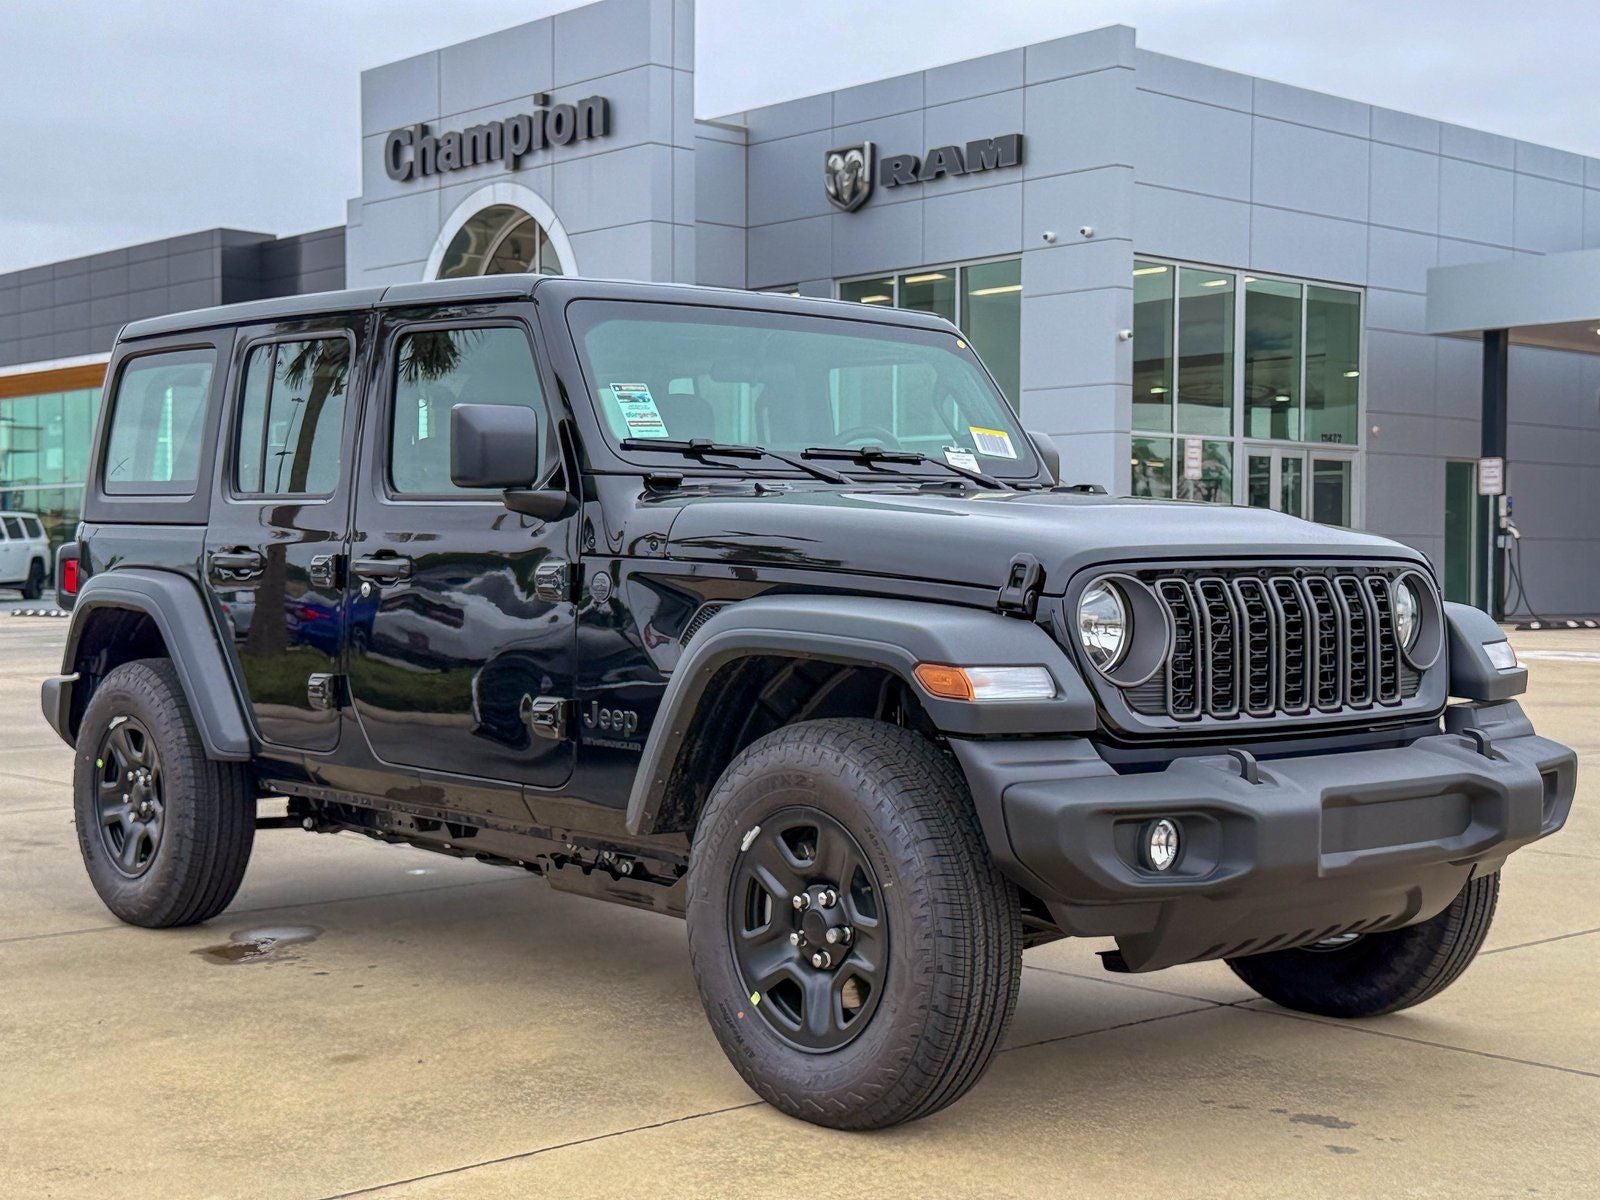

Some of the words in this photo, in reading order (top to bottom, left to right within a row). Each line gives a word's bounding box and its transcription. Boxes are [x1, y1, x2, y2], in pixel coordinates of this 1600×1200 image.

[384, 93, 610, 182] Champion
[880, 134, 1023, 188] RAM
[583, 700, 638, 738] Jeep
